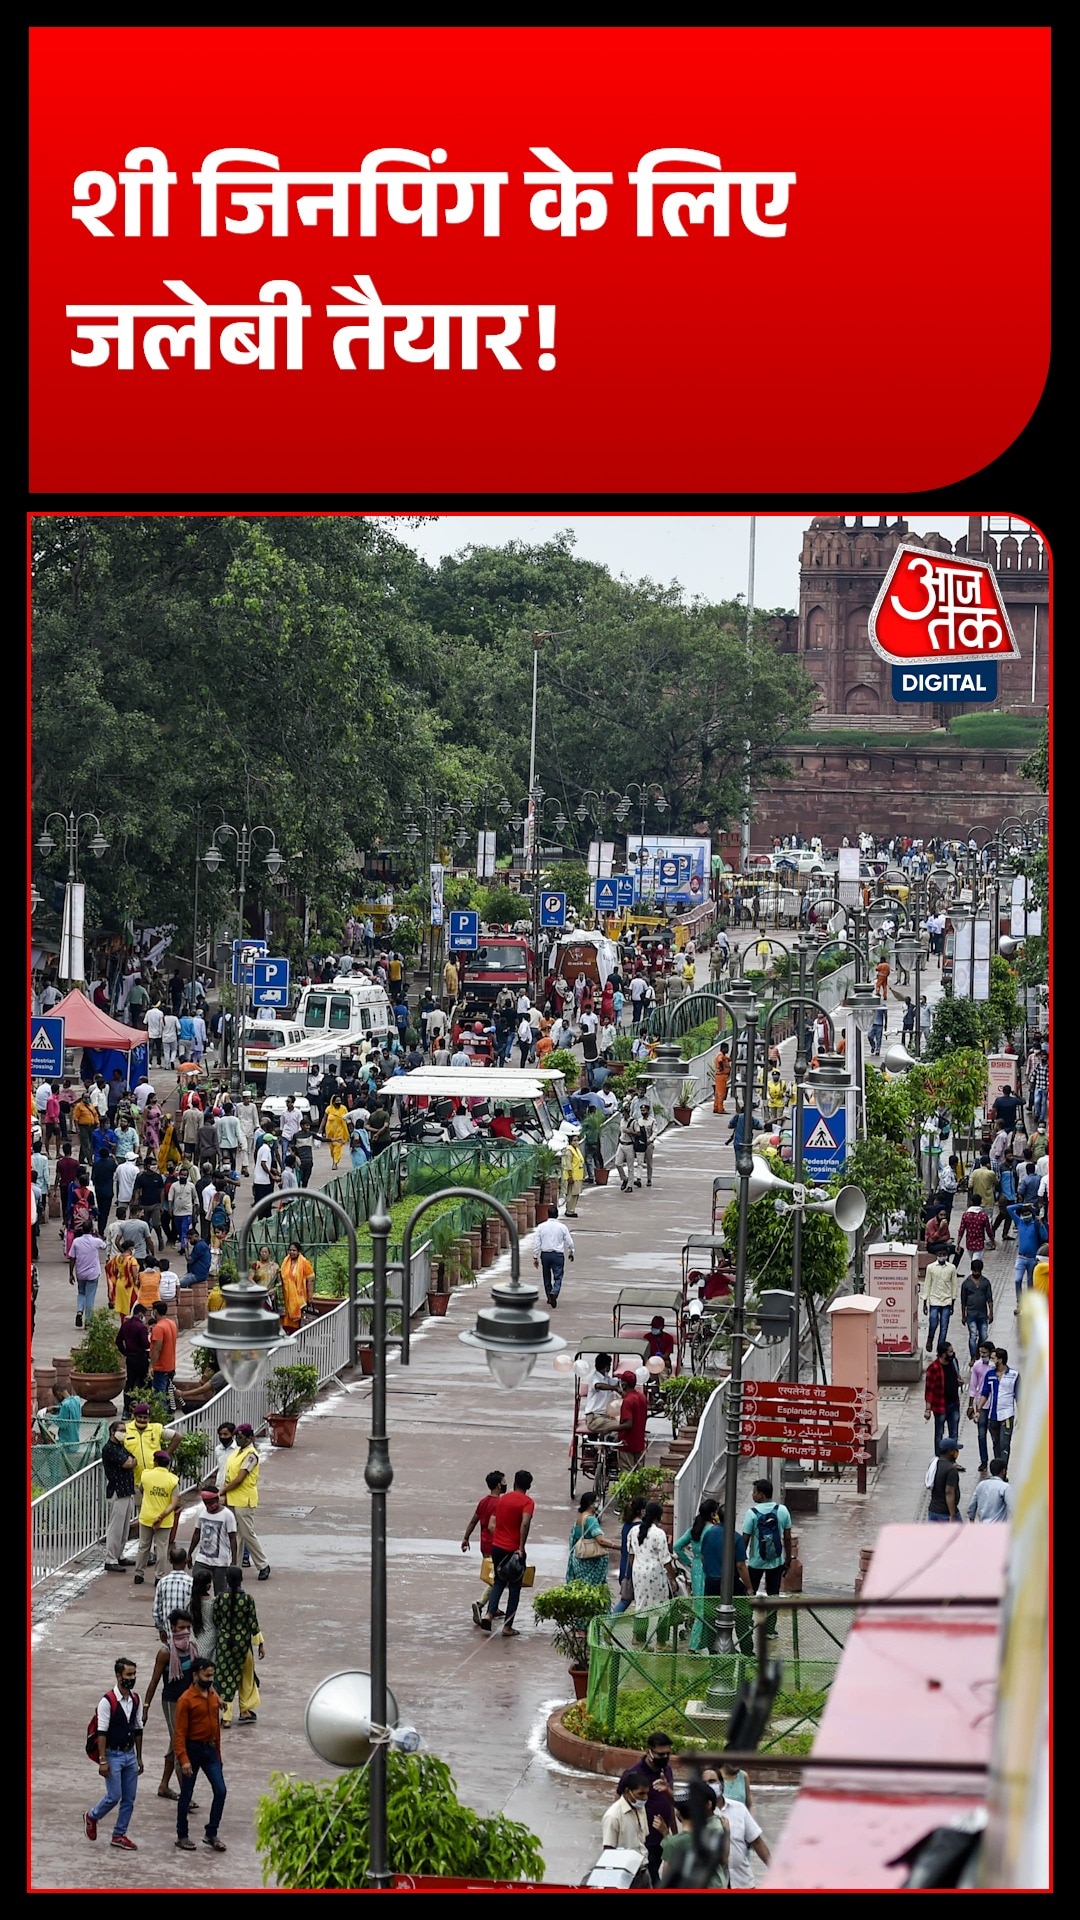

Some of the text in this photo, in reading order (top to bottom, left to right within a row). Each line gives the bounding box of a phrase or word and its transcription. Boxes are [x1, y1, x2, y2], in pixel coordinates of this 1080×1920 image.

[459, 915, 469, 931] P
[265, 964, 278, 982] P
[874, 1260, 907, 1268] BSES
[813, 1387, 827, 1397] रोड
[777, 1405, 840, 1418] Esplanade Road
